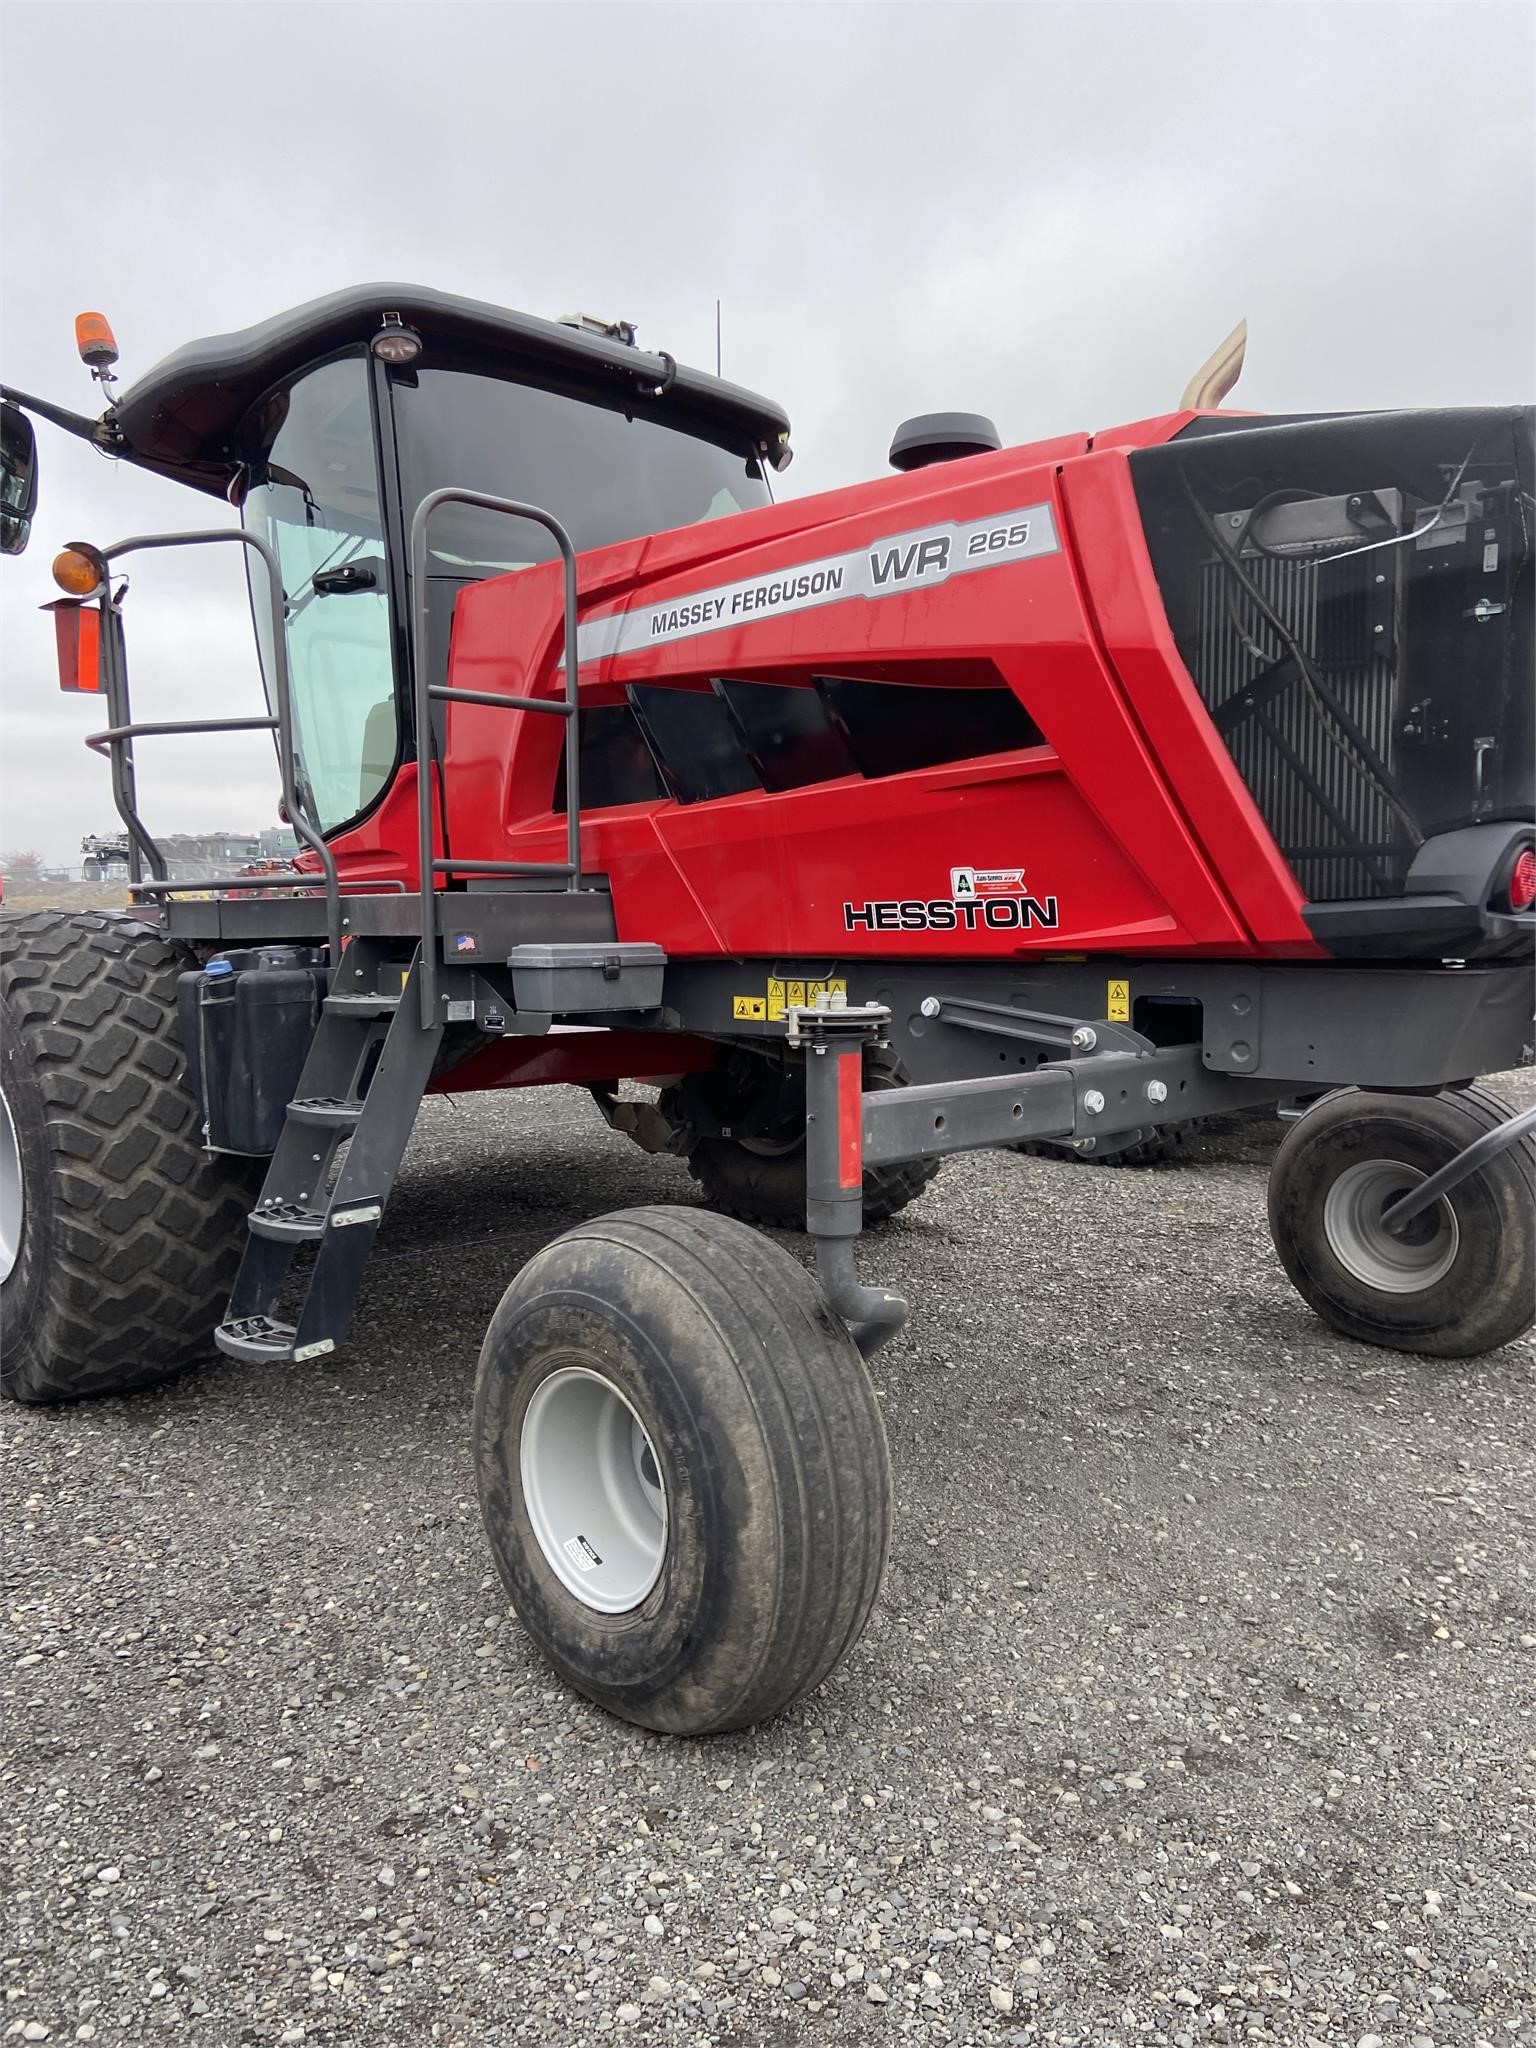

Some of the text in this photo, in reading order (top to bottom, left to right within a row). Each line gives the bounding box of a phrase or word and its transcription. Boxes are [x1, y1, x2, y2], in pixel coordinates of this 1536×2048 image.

[651, 523, 1030, 636] MASSEY FERGUSON WR 265
[844, 896, 1059, 931] HESSTON
